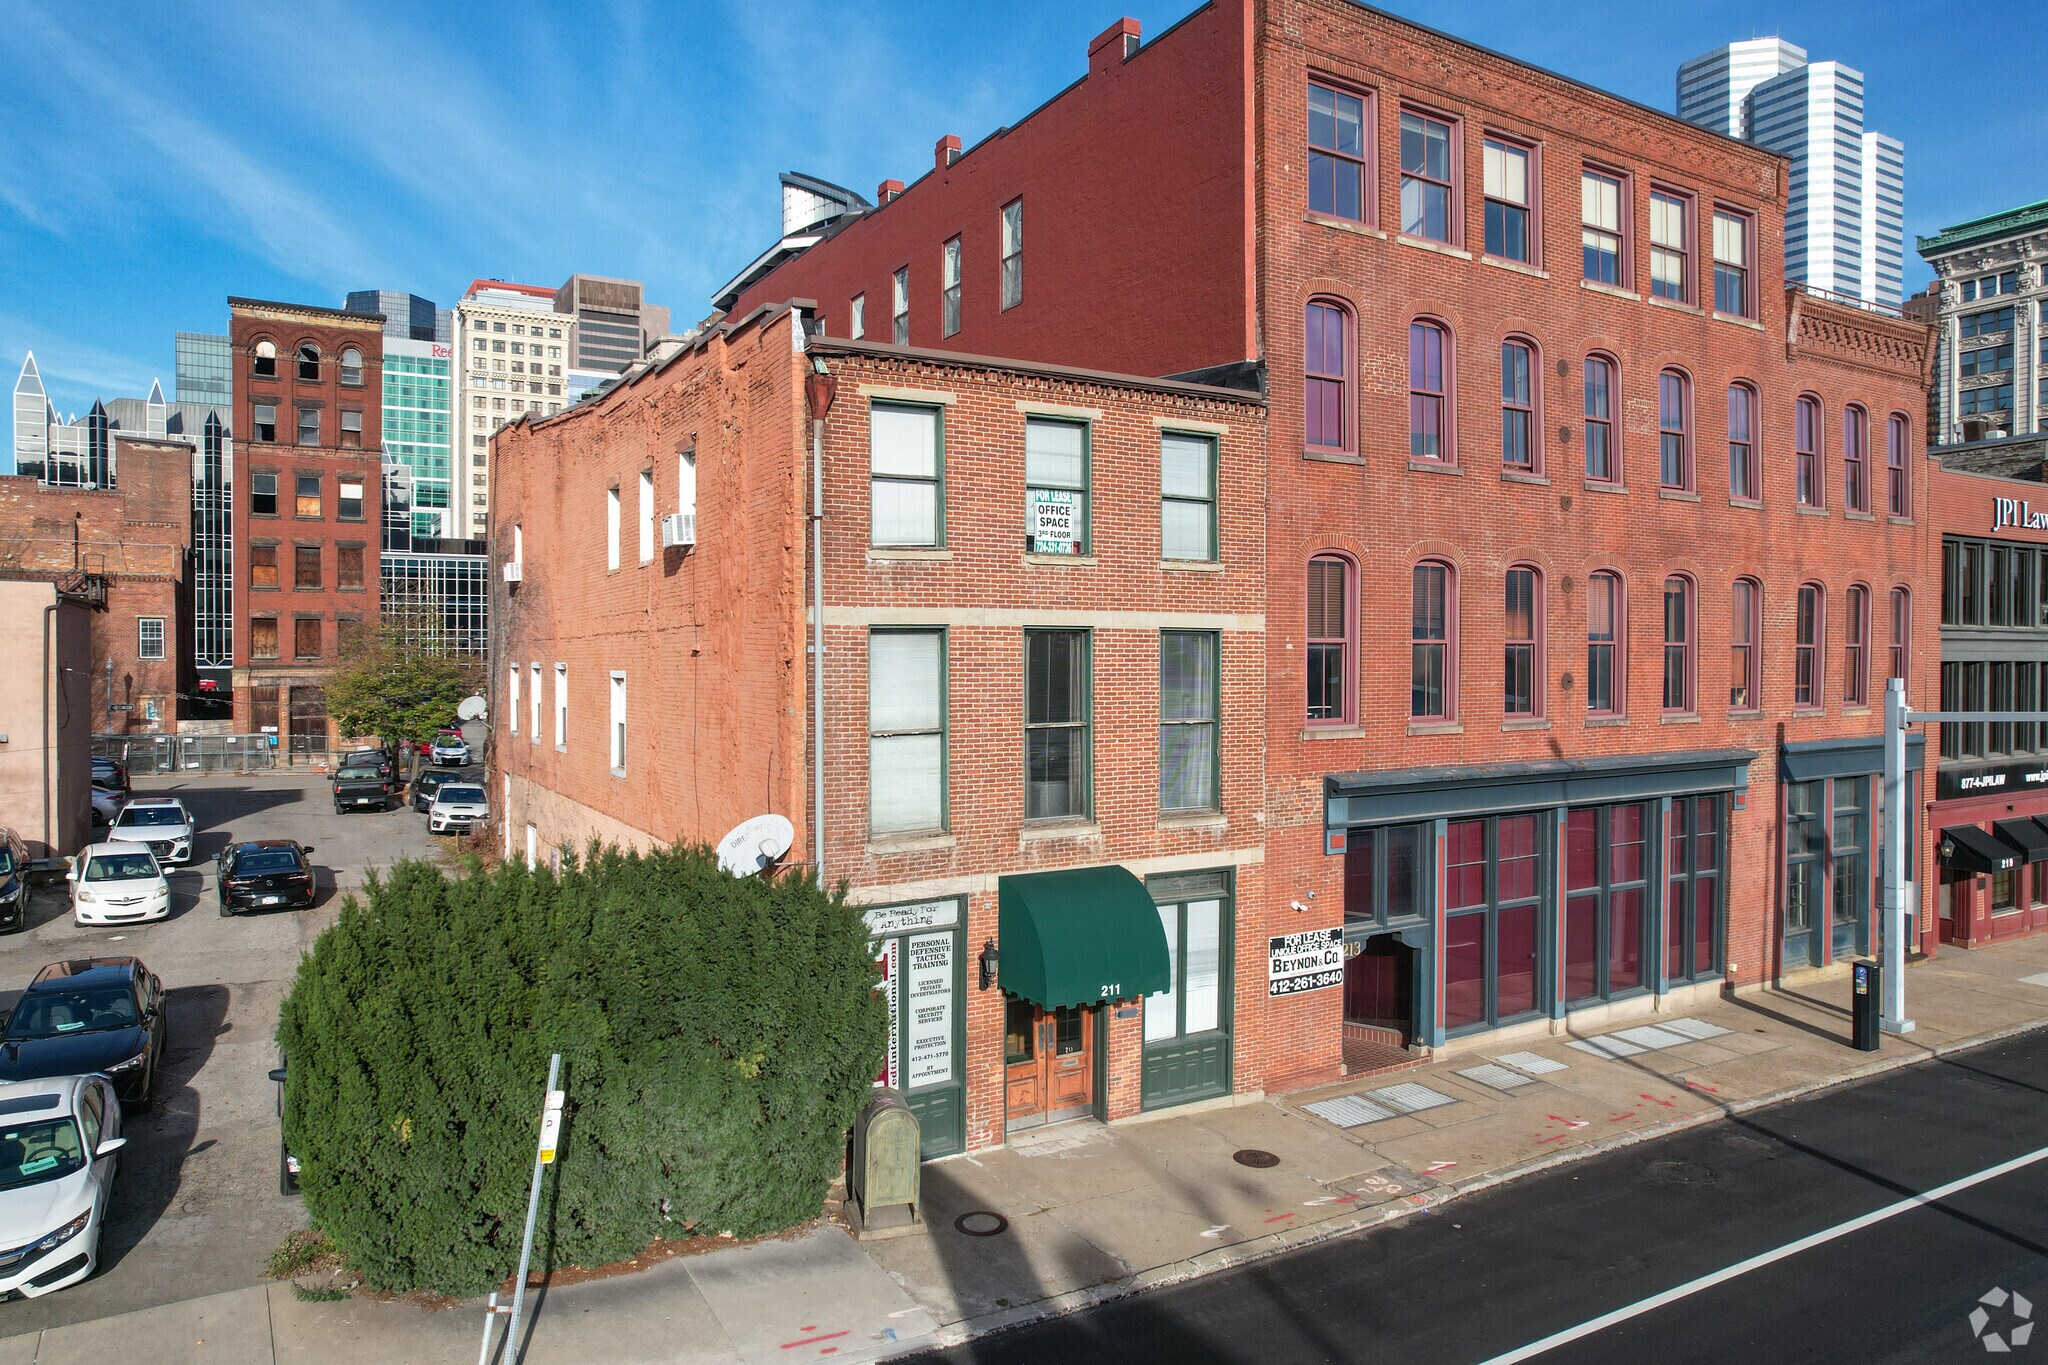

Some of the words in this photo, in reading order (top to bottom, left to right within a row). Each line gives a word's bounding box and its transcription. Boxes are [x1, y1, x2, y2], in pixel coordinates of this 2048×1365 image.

[1036, 490, 1050, 502] FOR
[1051, 490, 1072, 503] LEASE
[1038, 505, 1070, 516] OFFICE
[1993, 497, 2019, 531] JPI
[1040, 517, 1069, 528] SPACE
[1050, 531, 1071, 539] FLOOR
[1961, 774, 2006, 789] 877-4-JPILAW
[875, 911, 886, 919] Be
[890, 907, 918, 917] Ready
[920, 905, 939, 914] For
[880, 915, 933, 929] Anything
[911, 938, 950, 949] PERSONAL
[1284, 934, 1302, 948] FOR
[1303, 930, 1331, 943] LEASE
[910, 945, 951, 956] DEFENSIVE
[1271, 946, 1297, 958] UNIQUE
[1296, 943, 1320, 954] OFFICE
[1320, 938, 1342, 950] SPACE
[1343, 941, 1361, 957] 213
[915, 953, 946, 962] TACTICS
[912, 960, 949, 970] TRAINING
[1272, 955, 1318, 974] BEYNON
[1318, 958, 1323, 966] &
[917, 978, 944, 986] LICENSED
[1270, 970, 1342, 993] 412-261-3640
[910, 988, 951, 998] INVESTIGATORS
[1101, 983, 1120, 997] 211
[914, 1004, 946, 1014] CORPORATE
[917, 1011, 943, 1019] SECURITY
[917, 1016, 943, 1024] SERVICES
[913, 1040, 947, 1050] PROTECTION
[916, 1035, 945, 1044] EXECUTIVE
[911, 1051, 949, 1062] 412-471-5770
[911, 1067, 949, 1079] APPOINTMENT
